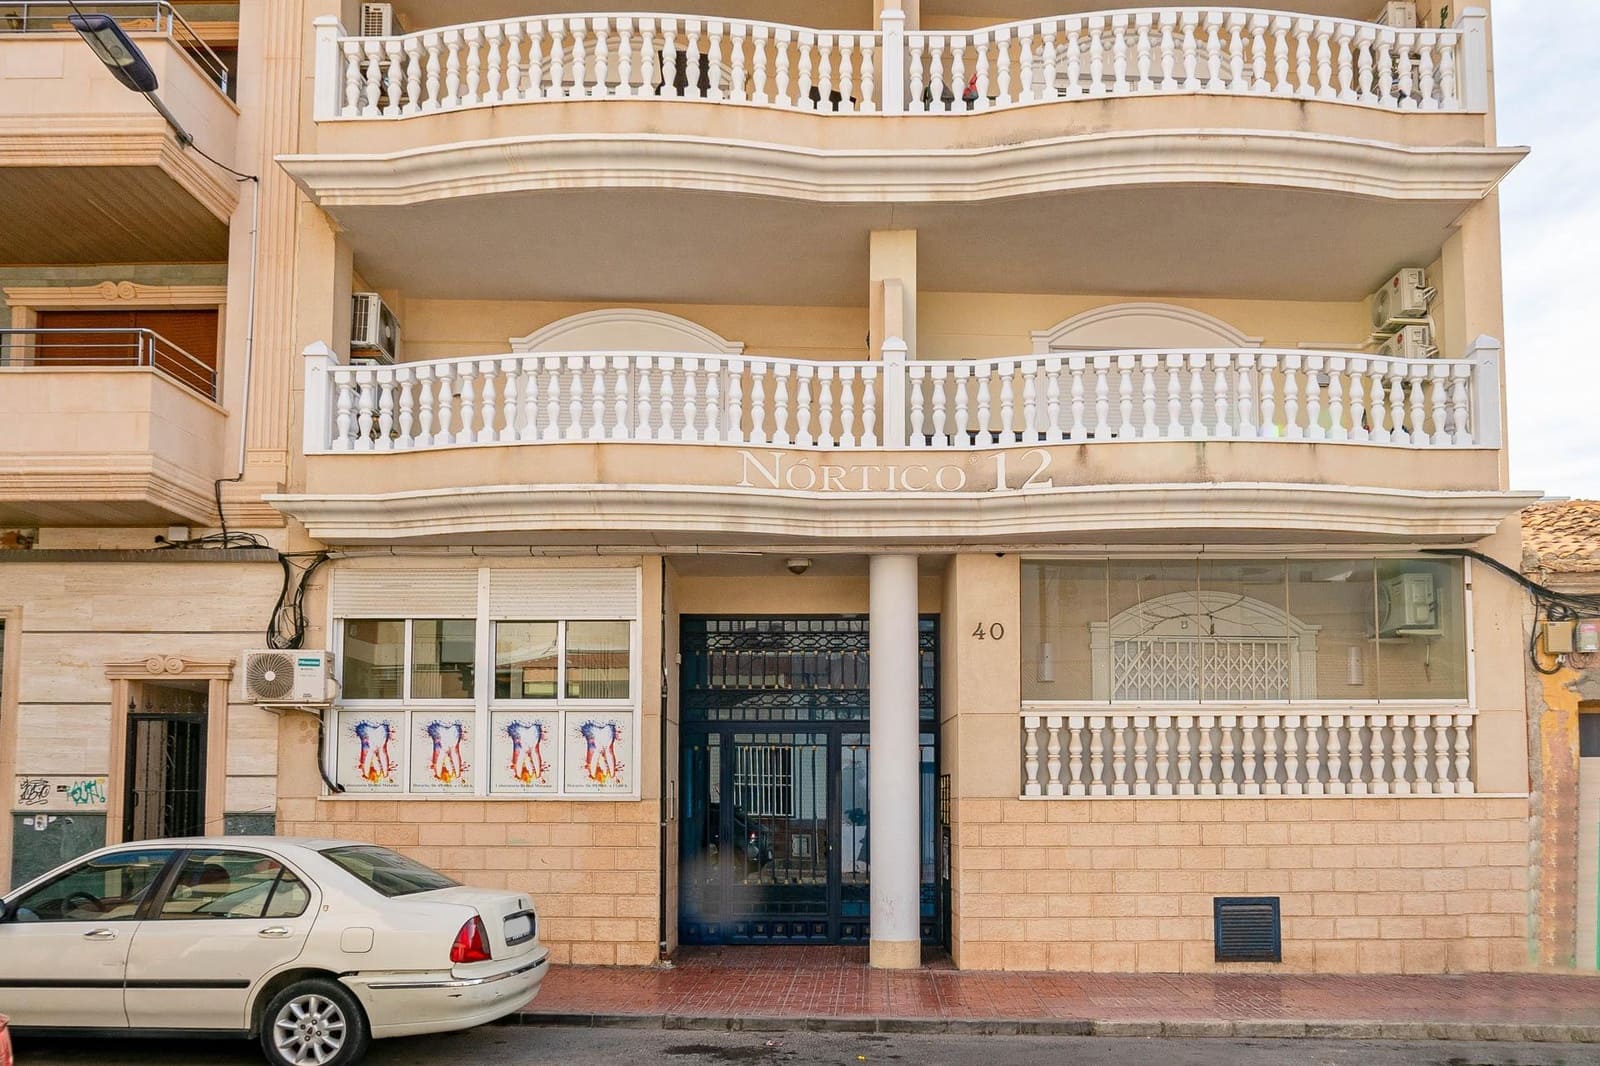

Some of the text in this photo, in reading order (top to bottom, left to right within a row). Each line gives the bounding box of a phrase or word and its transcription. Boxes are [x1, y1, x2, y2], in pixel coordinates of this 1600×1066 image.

[737, 448, 1053, 493] NÓRTICO 12
[972, 622, 1005, 640] 40
